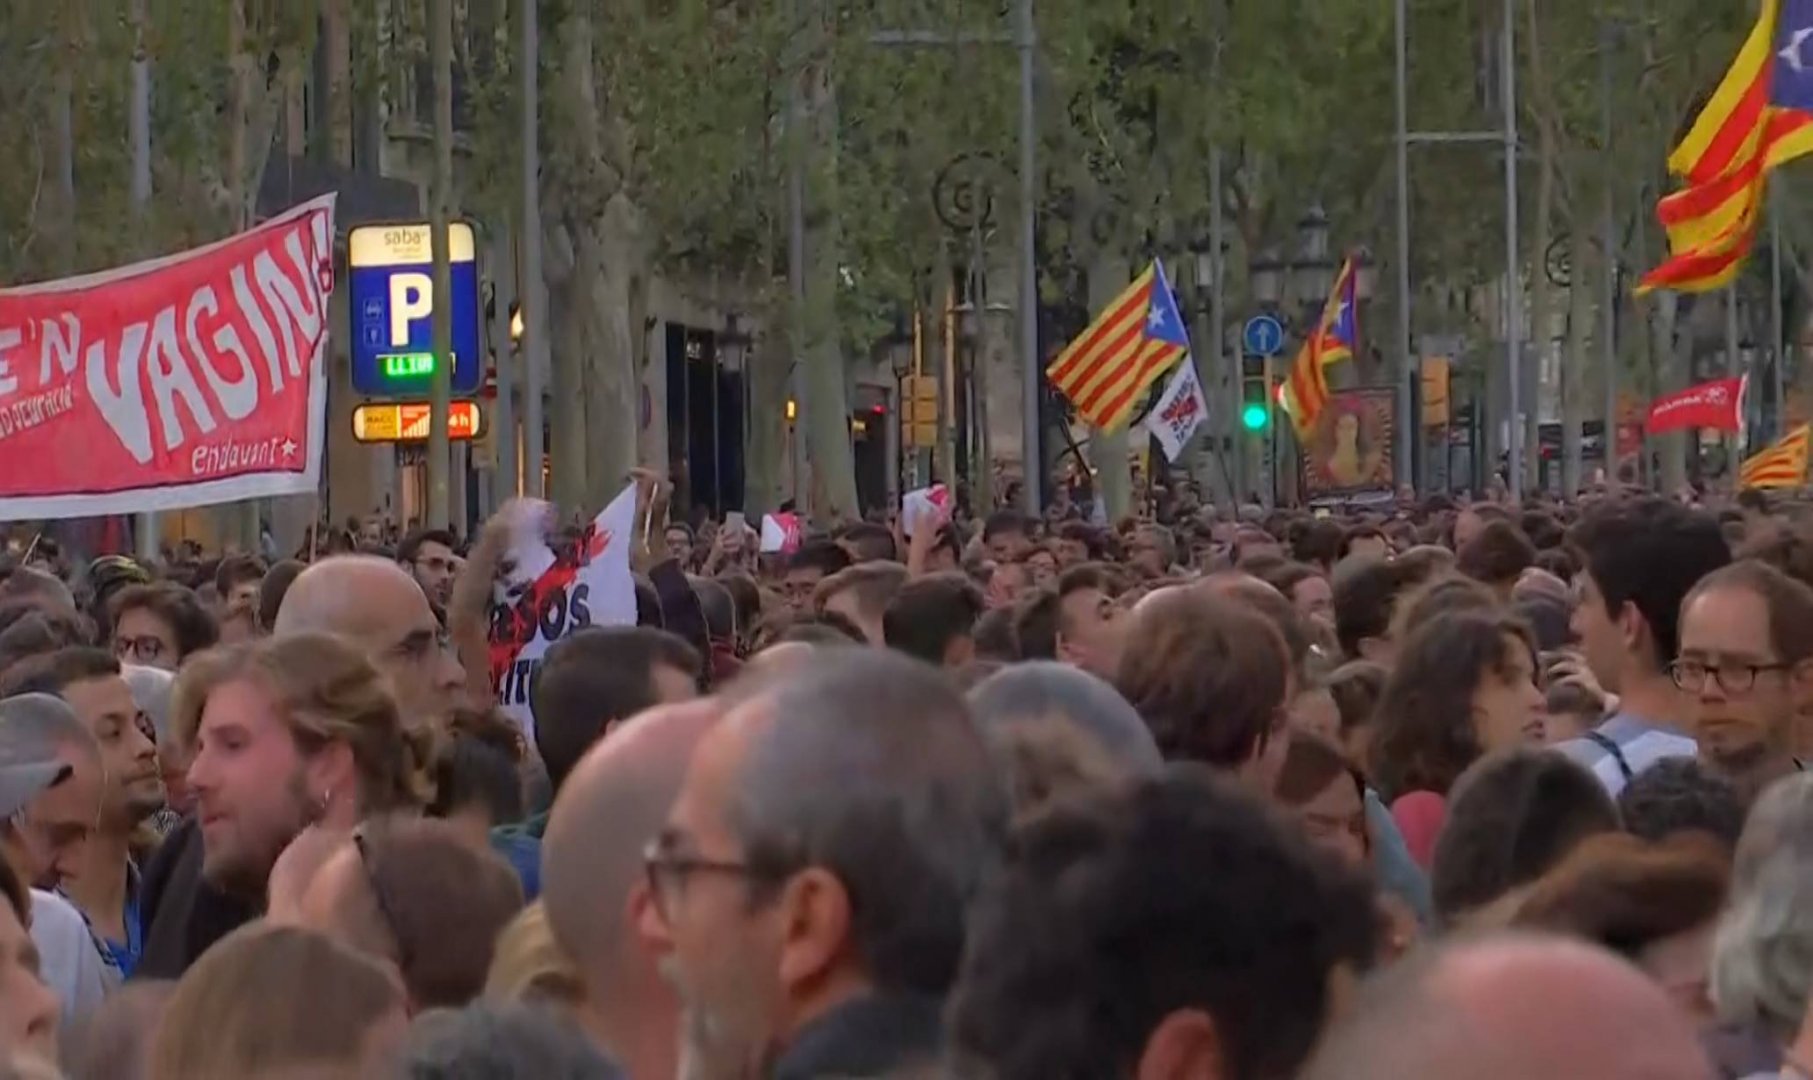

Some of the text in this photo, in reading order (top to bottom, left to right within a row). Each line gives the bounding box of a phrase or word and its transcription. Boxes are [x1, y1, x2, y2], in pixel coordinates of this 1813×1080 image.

[383, 227, 421, 246] saba
[85, 210, 334, 465] VAGIN!
[389, 272, 433, 347] P
[191, 433, 279, 475] endavant
